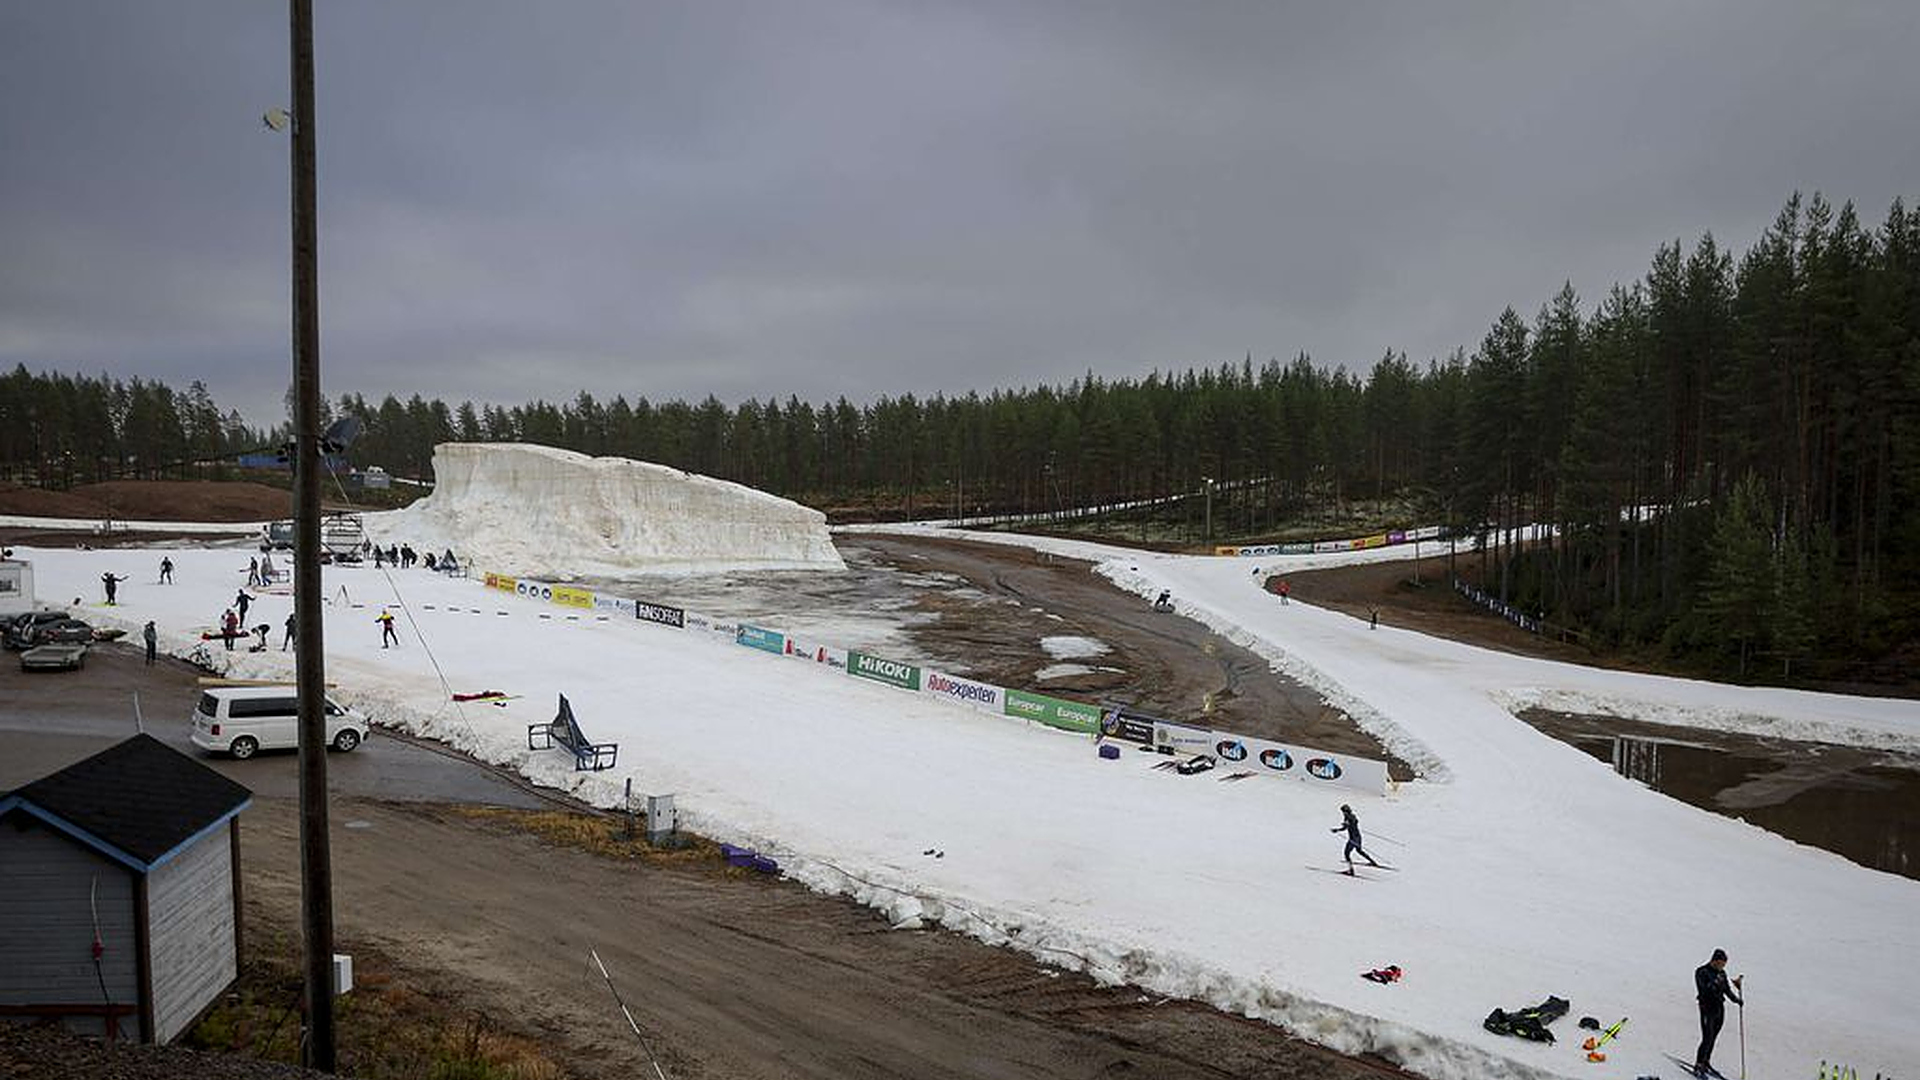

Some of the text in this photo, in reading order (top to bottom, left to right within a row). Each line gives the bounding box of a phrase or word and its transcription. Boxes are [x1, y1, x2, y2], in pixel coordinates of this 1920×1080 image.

[858, 655, 911, 679] HiKOKI
[928, 674, 996, 703] Autoexperten
[1056, 706, 1098, 724] Europcar
